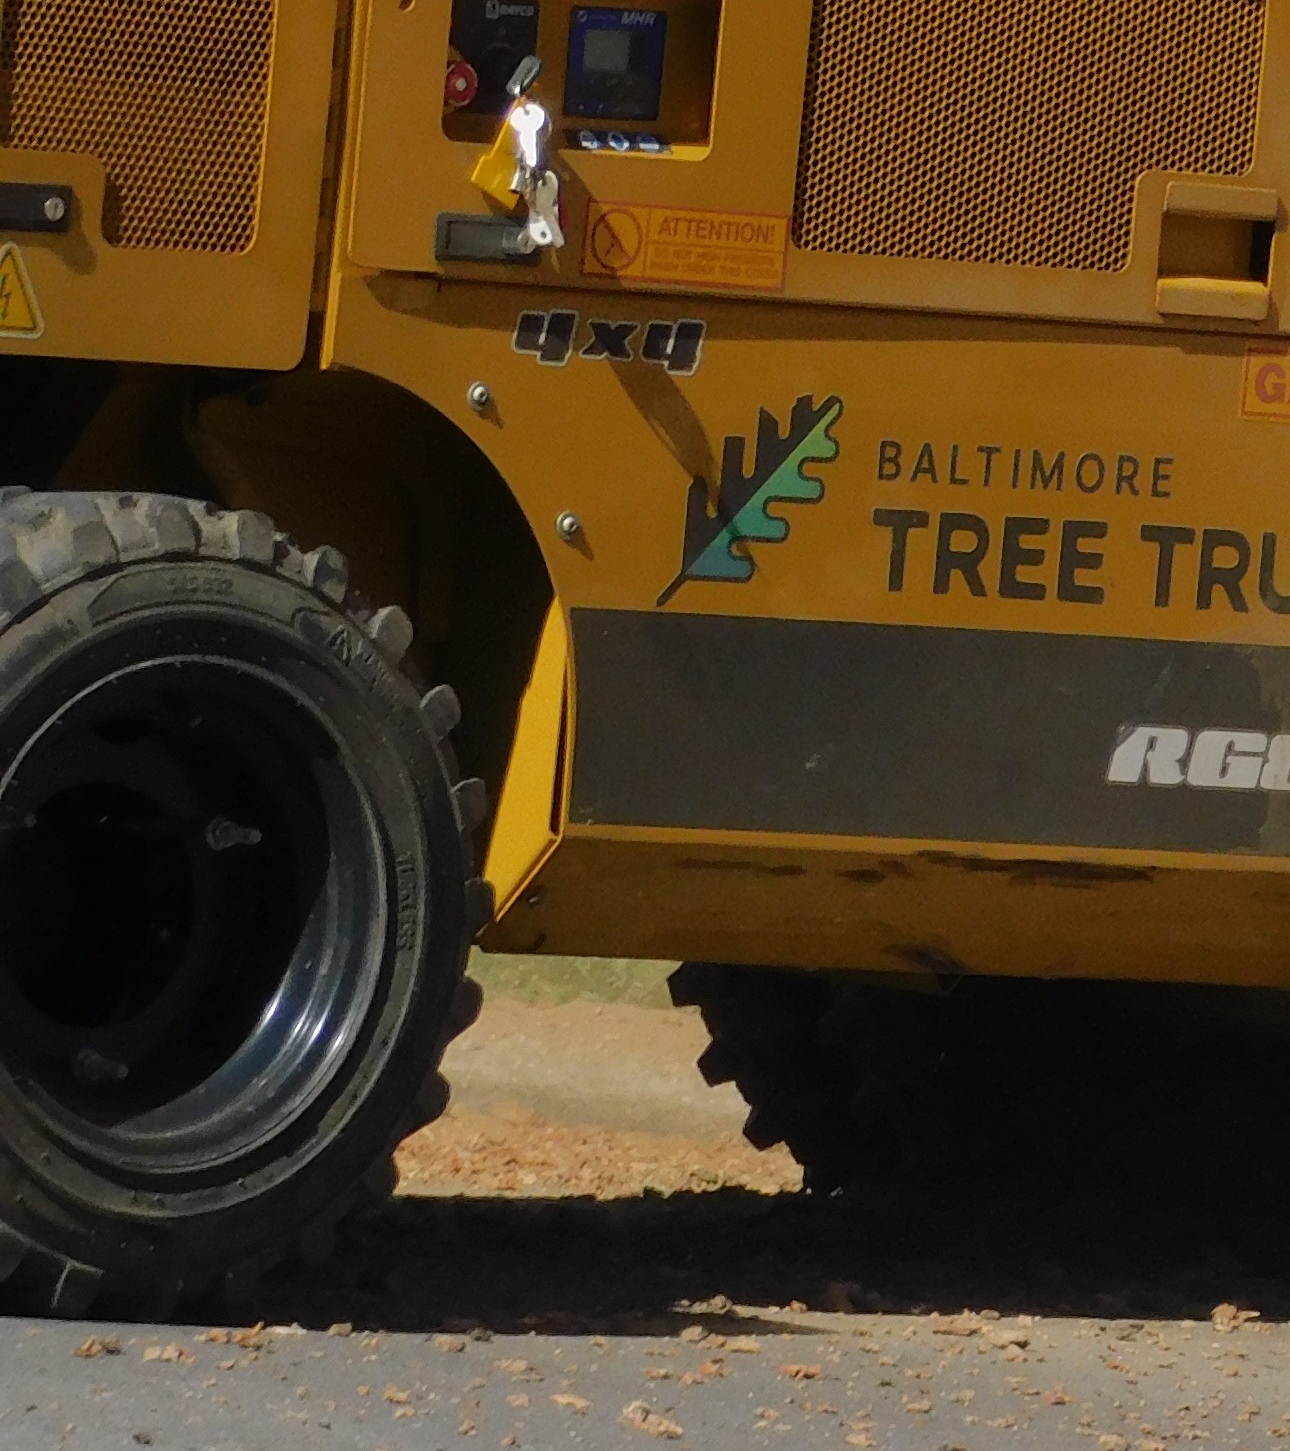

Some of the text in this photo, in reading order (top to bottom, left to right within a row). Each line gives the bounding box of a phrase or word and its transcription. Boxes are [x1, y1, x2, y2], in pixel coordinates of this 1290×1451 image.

[657, 216, 776, 246] ATTENTION!
[513, 309, 706, 376] 4x4
[876, 439, 1174, 499] BALTIMORE
[872, 507, 1109, 606] TREE
